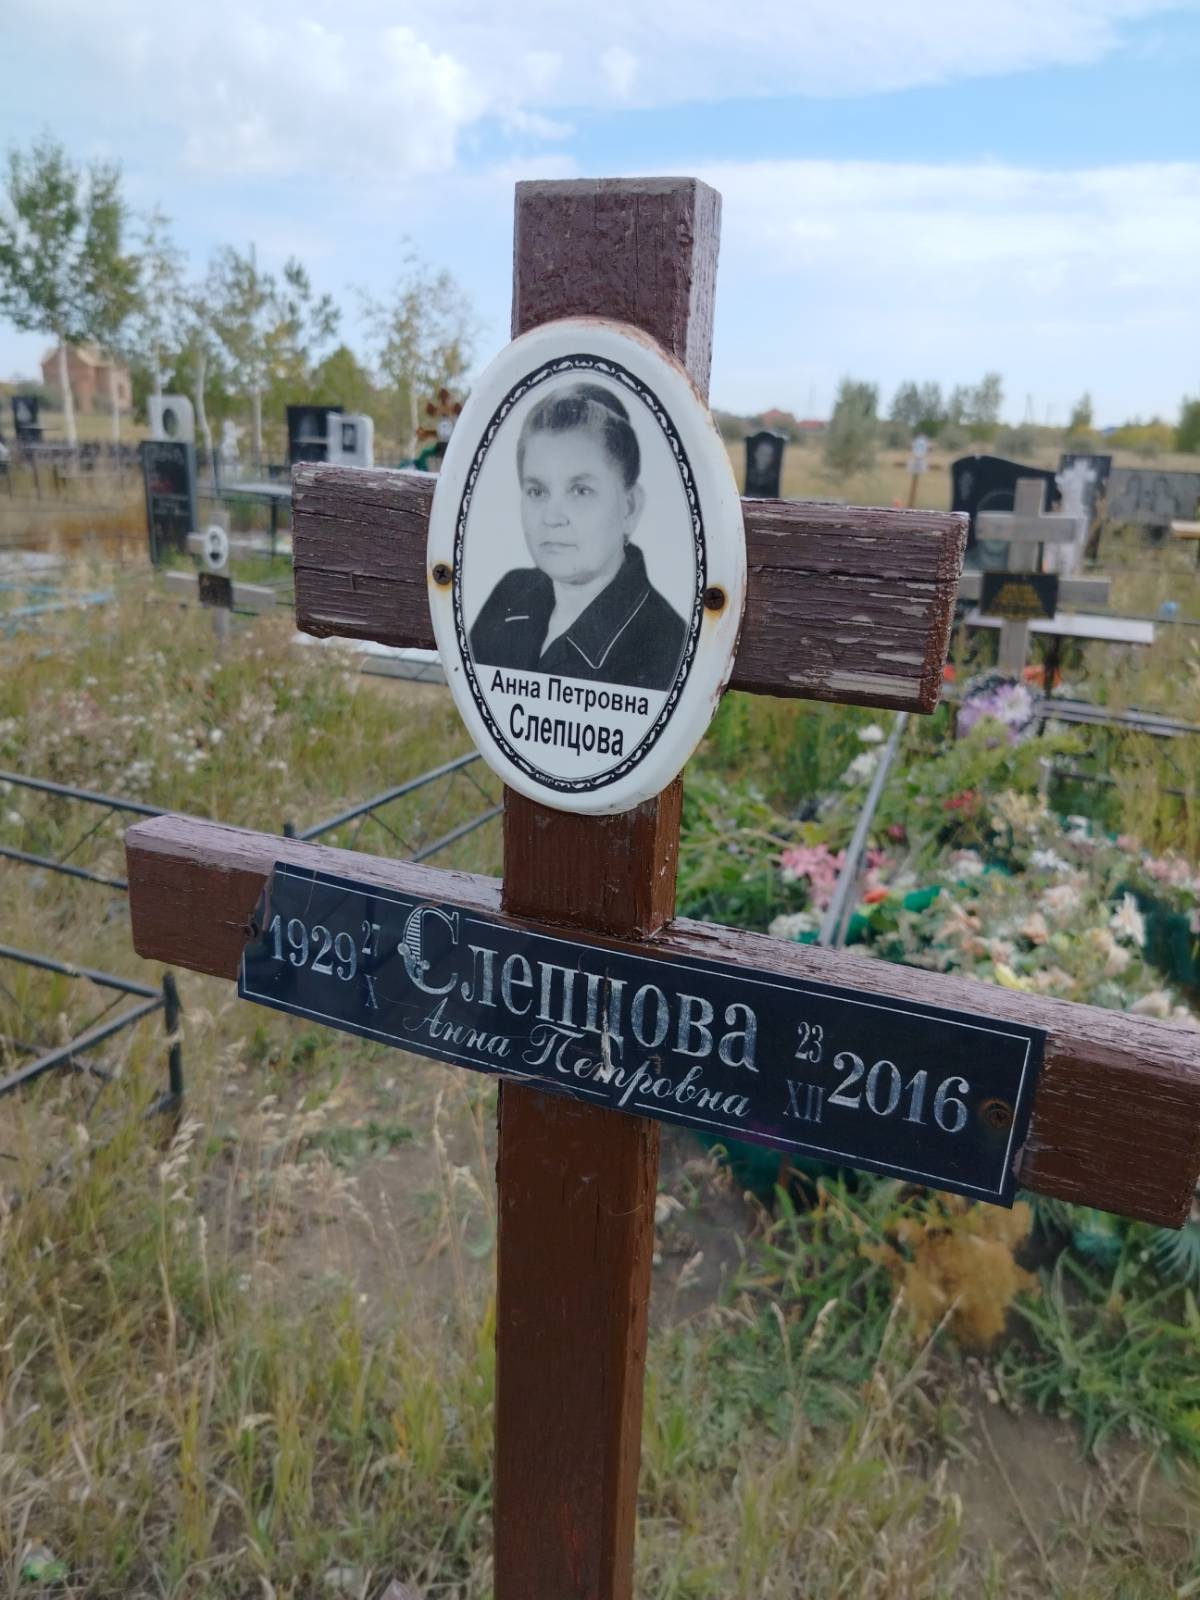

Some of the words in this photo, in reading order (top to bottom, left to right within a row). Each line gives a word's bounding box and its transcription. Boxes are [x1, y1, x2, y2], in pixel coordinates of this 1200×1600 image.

[491, 669, 541, 699] Анна
[548, 677, 649, 716] Петровна
[509, 703, 624, 757] Слепцова
[268, 914, 358, 982] 1929
[361, 919, 381, 958] 27
[396, 905, 760, 1073] Слепцова
[402, 997, 511, 1058] Анна
[521, 1023, 752, 1118] Петровна
[794, 1020, 825, 1064] 23
[827, 1050, 972, 1134] 2016
